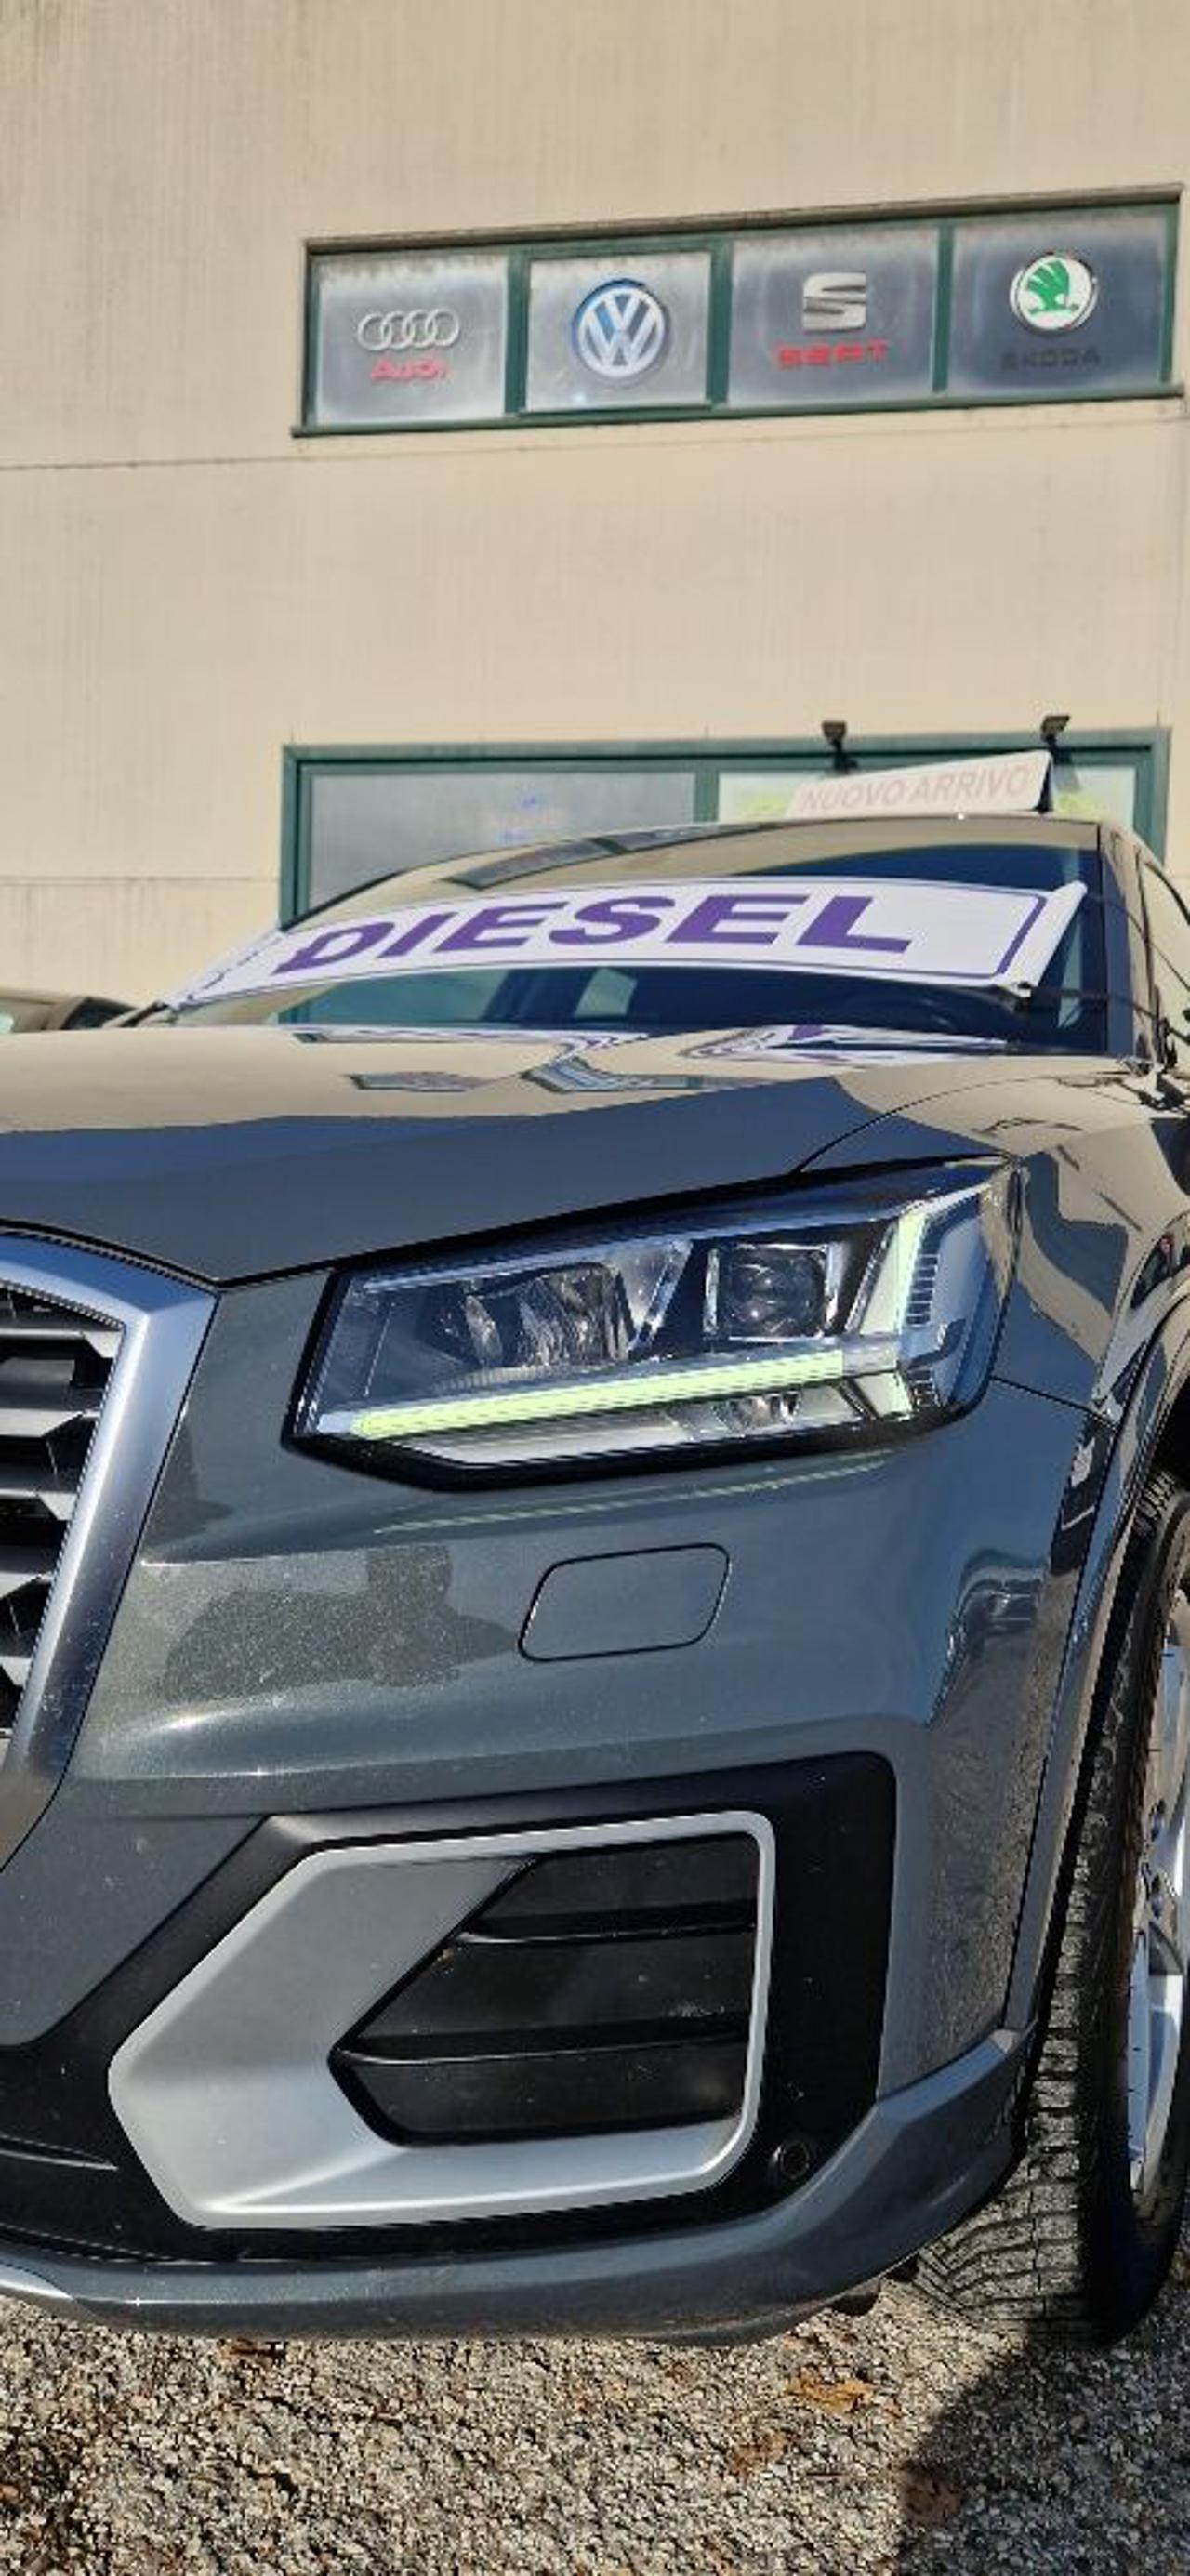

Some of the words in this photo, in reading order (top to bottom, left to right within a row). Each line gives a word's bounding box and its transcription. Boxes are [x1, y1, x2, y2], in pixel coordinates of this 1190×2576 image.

[371, 356, 450, 381] Audi
[778, 338, 890, 370] SEAT
[799, 779, 907, 812] NUOVO
[909, 763, 1031, 804] ARRIVO
[271, 892, 913, 975] DIESEL
